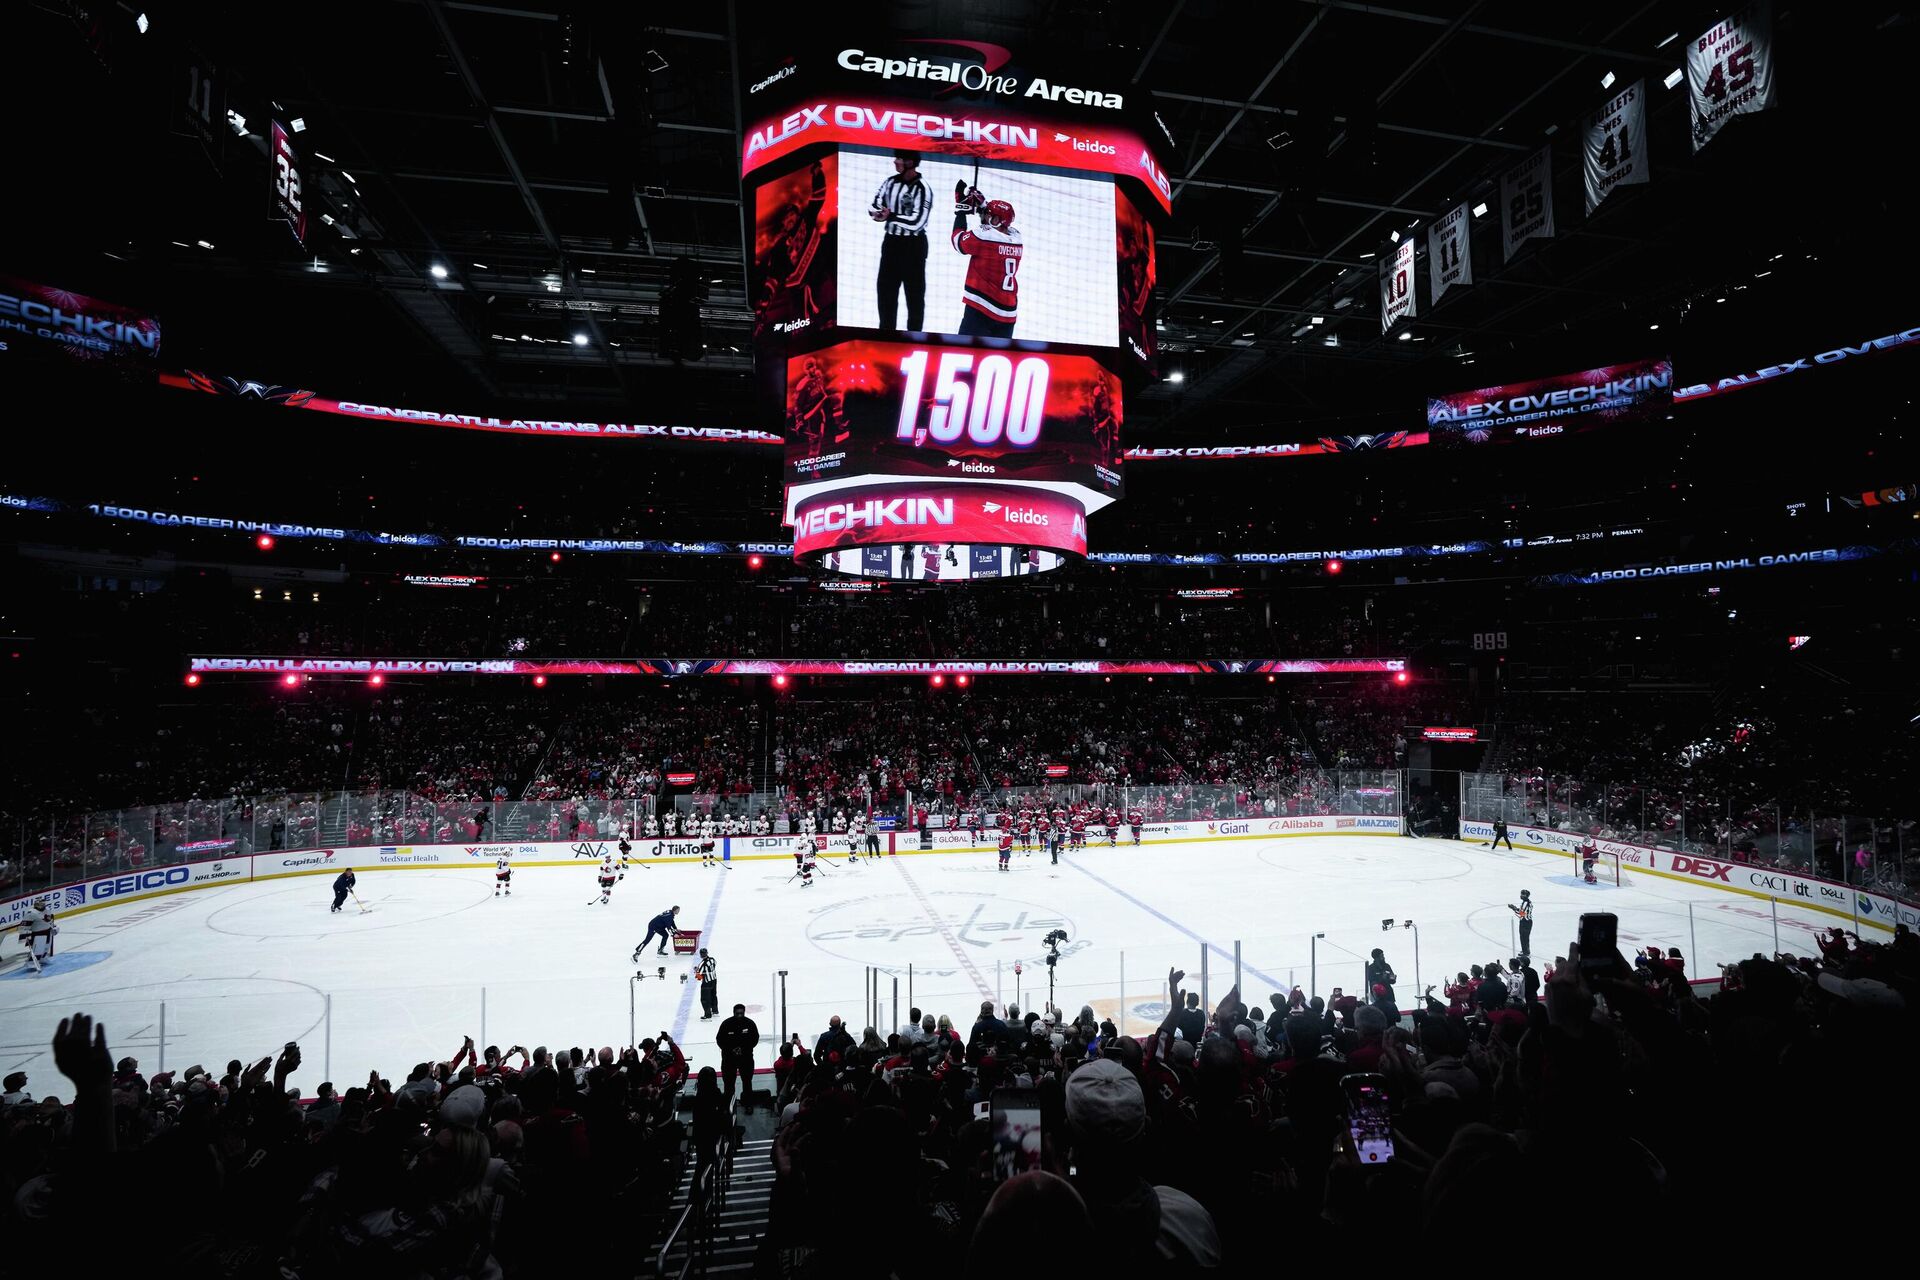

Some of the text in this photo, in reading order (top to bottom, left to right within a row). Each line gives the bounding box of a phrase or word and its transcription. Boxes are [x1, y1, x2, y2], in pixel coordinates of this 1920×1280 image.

[1698, 8, 1752, 53] BULLE
[1715, 34, 1742, 60] PHIL
[1703, 43, 1753, 105] 45
[1024, 78, 1123, 110] Arena
[746, 104, 1038, 160] ALEX OVECHKIN
[1603, 115, 1622, 134] WES
[1073, 137, 1116, 155] leidos
[1600, 125, 1632, 172] 41
[276, 153, 302, 214] 32
[1599, 163, 1633, 191] UNSELD
[1510, 186, 1543, 230] 25
[1433, 207, 1464, 235] BULLETS
[1440, 238, 1459, 273] 11
[1002, 257, 1017, 291] 8
[1388, 270, 1407, 305] 10
[784, 317, 811, 333] leidos
[36, 327, 112, 352] GAMES
[1717, 358, 1813, 390] ALEX
[896, 349, 1050, 448] 1,500
[1434, 372, 1670, 423] ALEX OVECHKIN
[338, 401, 600, 433] CONGRATULATIONS
[605, 424, 669, 436] ALEX
[1495, 410, 1548, 425] CAREER
[1550, 406, 1578, 418] NHL
[1580, 397, 1633, 412] GAMES
[1529, 424, 1564, 437] leidos
[815, 452, 846, 463] CAREER
[1126, 443, 1300, 456] ALEX OVECHKIN
[798, 460, 840, 472] NHL GAMES
[962, 462, 996, 474] leidos
[151, 512, 234, 529] CAREER
[237, 520, 277, 532] NHL
[279, 524, 345, 539] GAMES
[1004, 506, 1049, 526] leidos
[391, 534, 417, 544] leidos
[500, 538, 558, 548] CAREER
[560, 540, 588, 549] NHL
[592, 540, 644, 550] GAMES
[1442, 544, 1466, 552] leidos
[1109, 552, 1150, 562] GAMES
[1269, 552, 1322, 561] CAREER
[1323, 550, 1348, 559] NHL
[1352, 548, 1403, 558] GAMES
[1639, 562, 1712, 578] CAREER
[1715, 558, 1756, 571] NHL
[1758, 549, 1839, 567] GAMES
[374, 660, 423, 672] ALEX
[425, 660, 514, 672] OVECHKIN
[844, 662, 1099, 672] CONGRATULATIONS ALEX OVECHKIN
[1219, 821, 1250, 835] Giant
[1282, 820, 1324, 829] Alibaba
[1356, 818, 1398, 828] AMAZING
[752, 838, 794, 847] GDIT
[939, 835, 968, 843] GLOBAL
[380, 854, 439, 863] MedStar Health
[667, 844, 703, 855] TikTo
[1671, 855, 1734, 883] DEX
[91, 867, 189, 900] GEICO
[1750, 872, 1787, 892] CACI
[11, 891, 61, 911] UNIED
[1820, 885, 1846, 900] DELL
[811, 903, 1067, 949] captals
